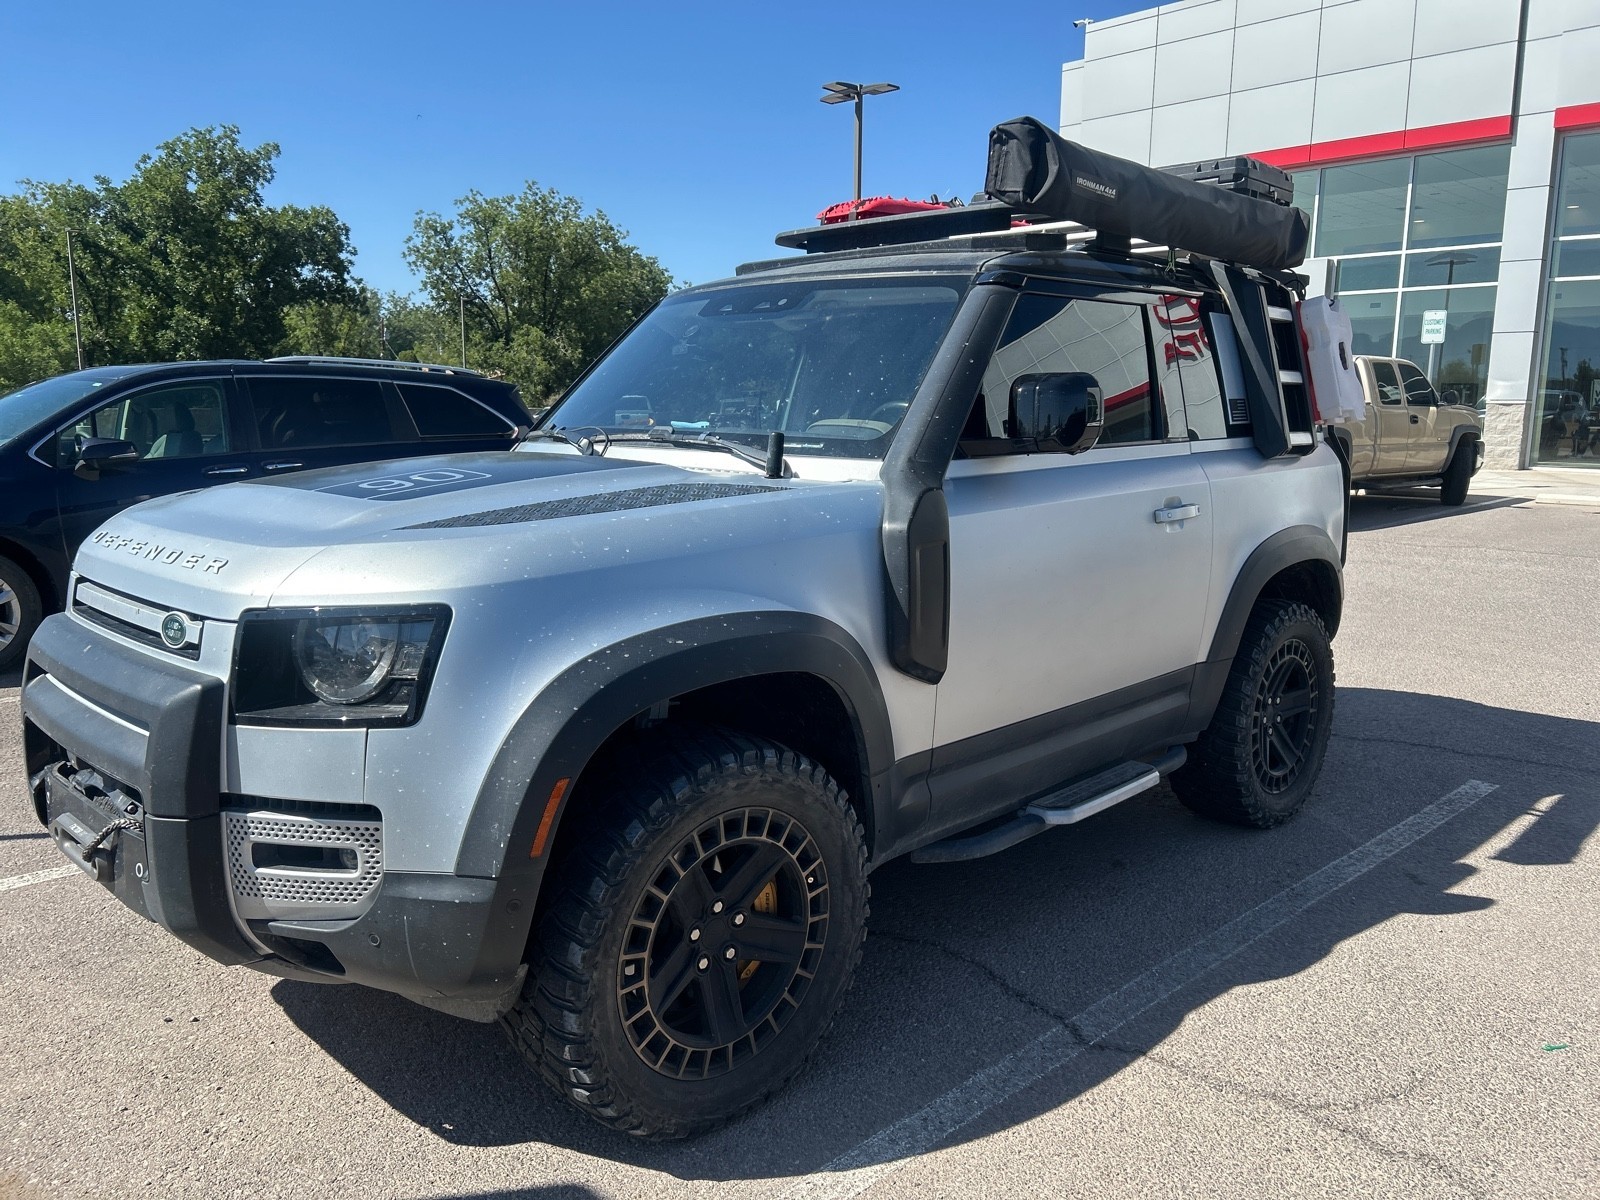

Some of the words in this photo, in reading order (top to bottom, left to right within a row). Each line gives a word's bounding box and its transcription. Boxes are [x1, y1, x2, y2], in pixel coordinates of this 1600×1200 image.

[1076, 176, 1105, 192] IRONMAN
[1424, 318, 1444, 326] CUSTOMER
[1425, 327, 1442, 335] PARKING
[358, 471, 465, 491] 90
[92, 531, 229, 574] DEFENDER
